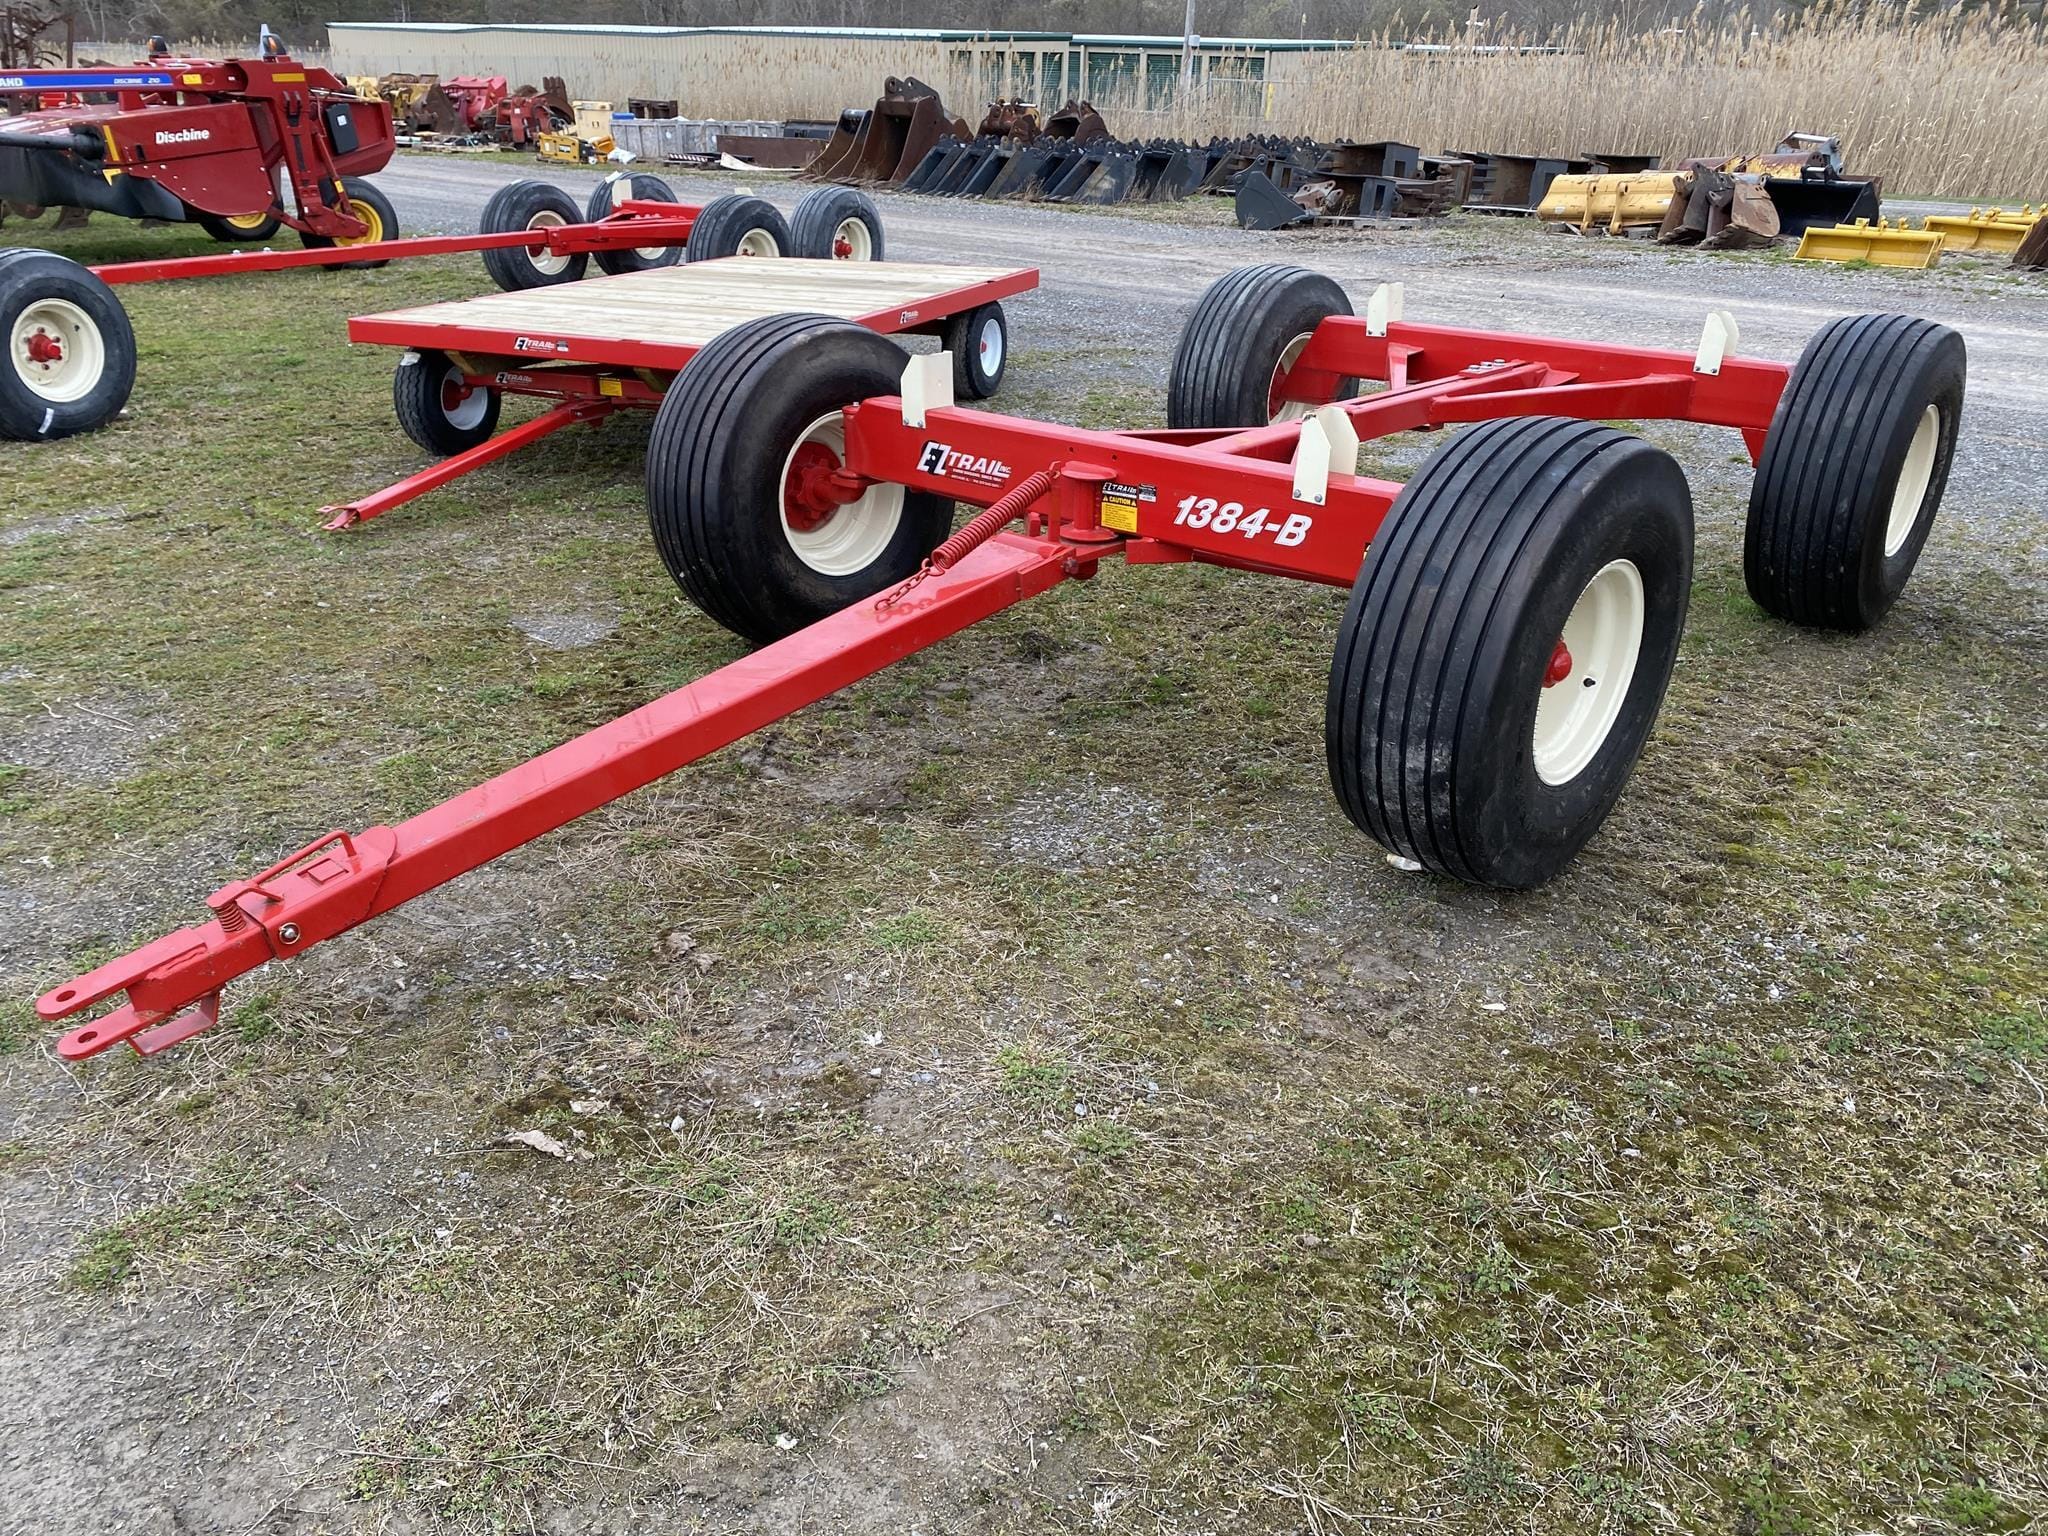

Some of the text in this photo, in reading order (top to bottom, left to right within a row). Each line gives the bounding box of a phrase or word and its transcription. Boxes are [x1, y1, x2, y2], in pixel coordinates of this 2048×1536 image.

[155, 128, 210, 144] Discbine
[947, 451, 1010, 478] TRAIL
[1109, 496, 1131, 505] CAUTION
[1173, 495, 1313, 547] 1384-B
